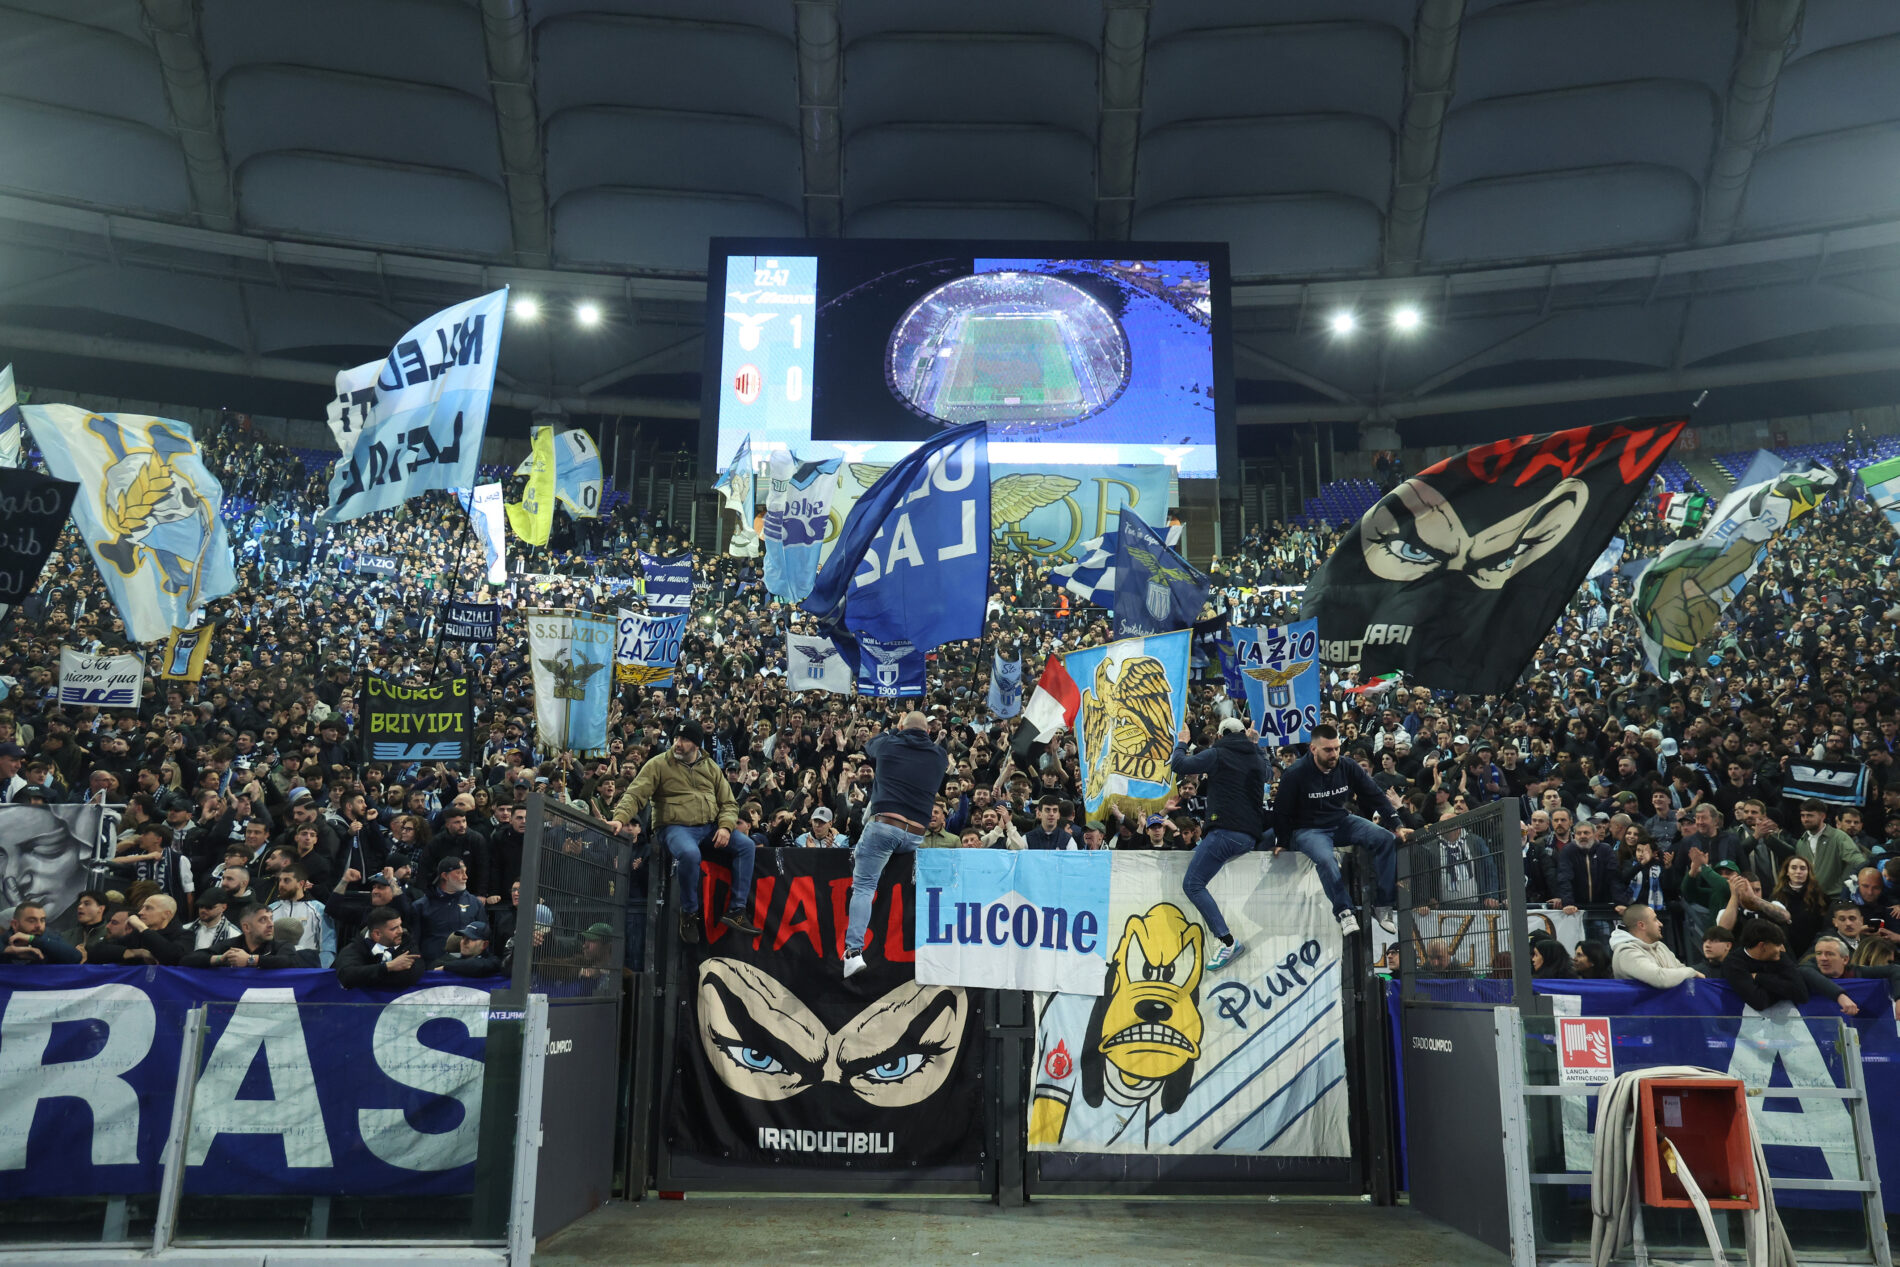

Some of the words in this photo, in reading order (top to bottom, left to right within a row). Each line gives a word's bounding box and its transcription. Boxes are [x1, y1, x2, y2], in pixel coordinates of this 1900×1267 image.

[789, 314, 803, 349] 1
[786, 366, 803, 402] 0
[361, 557, 395, 570] LAZIO
[452, 609, 494, 623] LAZIALI
[445, 624, 472, 636] SONO
[620, 616, 682, 640] C'MON
[617, 637, 680, 664] LAZIO
[81, 656, 112, 671] Noi
[63, 669, 102, 684] siamo
[107, 673, 137, 689] qua
[452, 678, 467, 697] E
[877, 686, 898, 696] 1900
[370, 712, 464, 734] BRIVIDI
[1260, 704, 1317, 738] ADS
[1109, 754, 1156, 779] AZIO
[925, 886, 1098, 954] Lucone
[549, 1039, 573, 1055] OLIMPICO
[1412, 1036, 1428, 1050] STADIO
[1428, 1037, 1453, 1053] OLIMPICO
[758, 1126, 895, 1154] IRRIDUCIBILI
